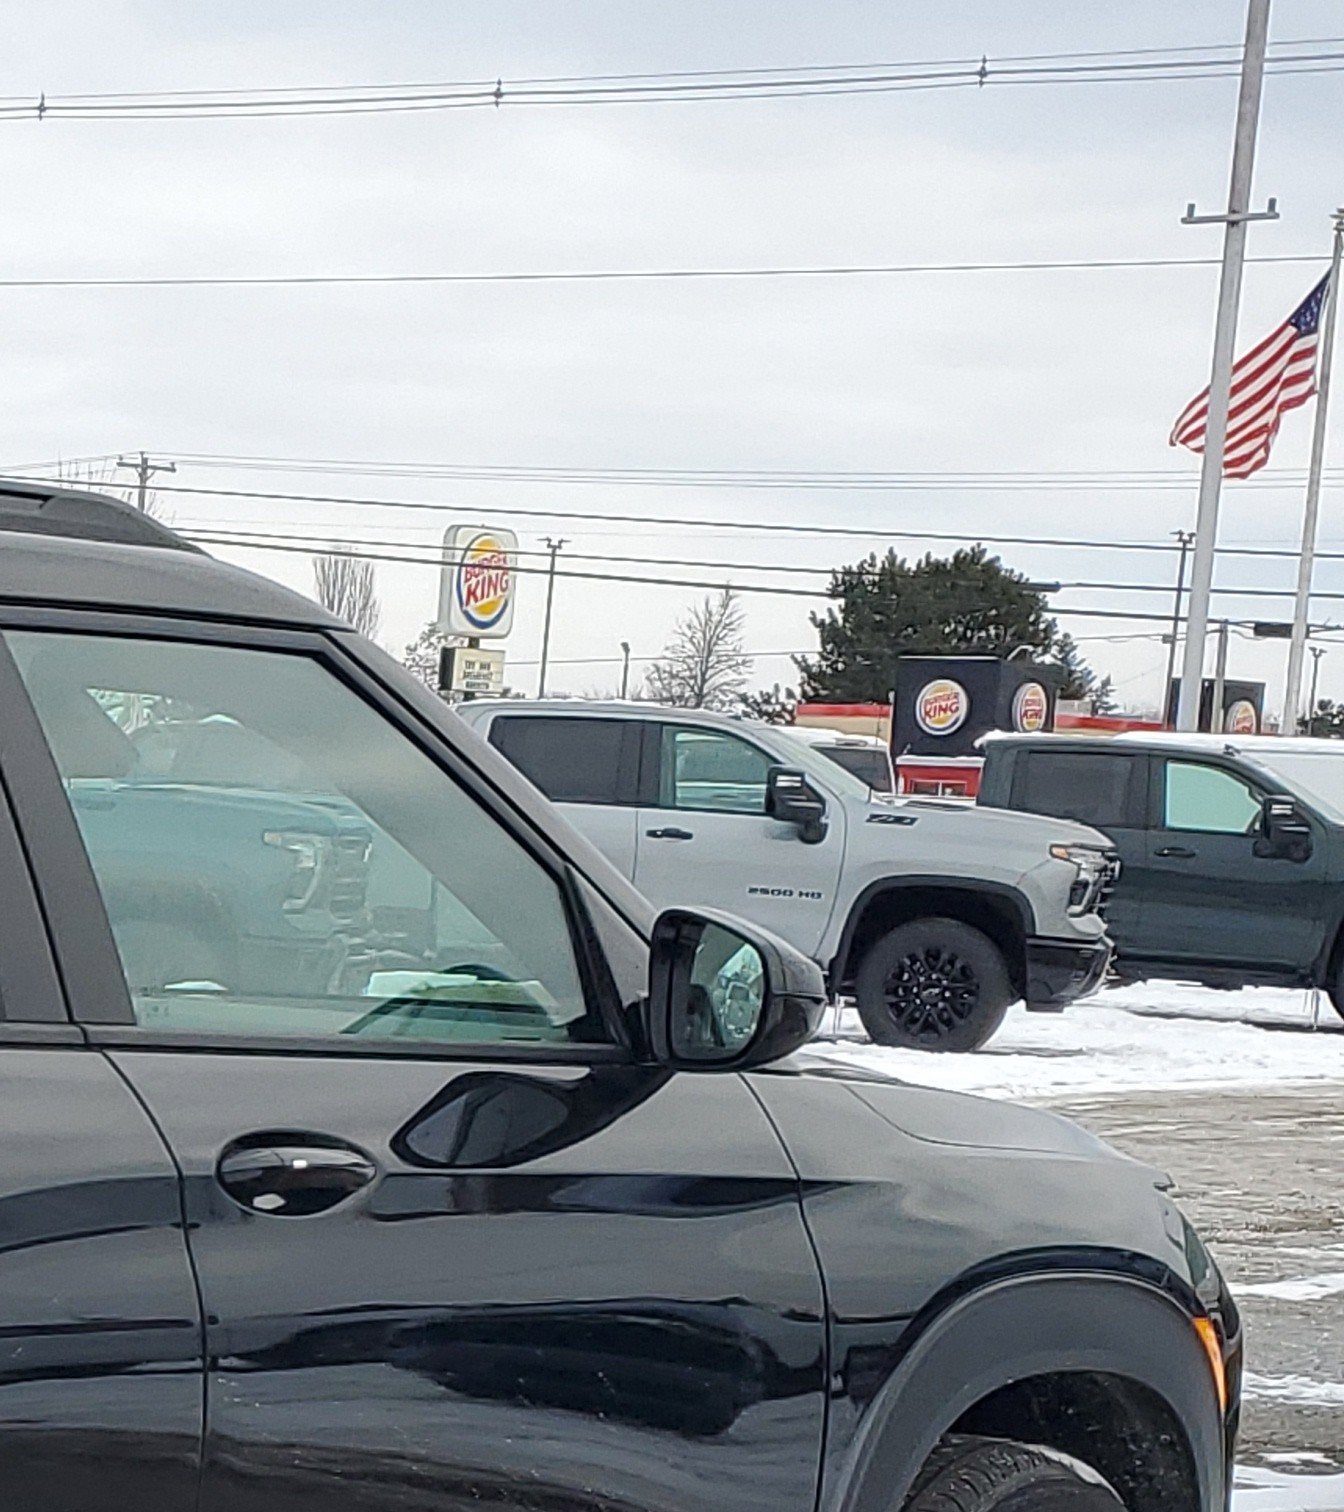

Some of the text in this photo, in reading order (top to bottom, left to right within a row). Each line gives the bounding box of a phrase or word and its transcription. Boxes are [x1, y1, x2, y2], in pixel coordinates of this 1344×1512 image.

[465, 571, 509, 607] KING
[924, 701, 960, 720] KING
[748, 886, 823, 900] 2500 HD
